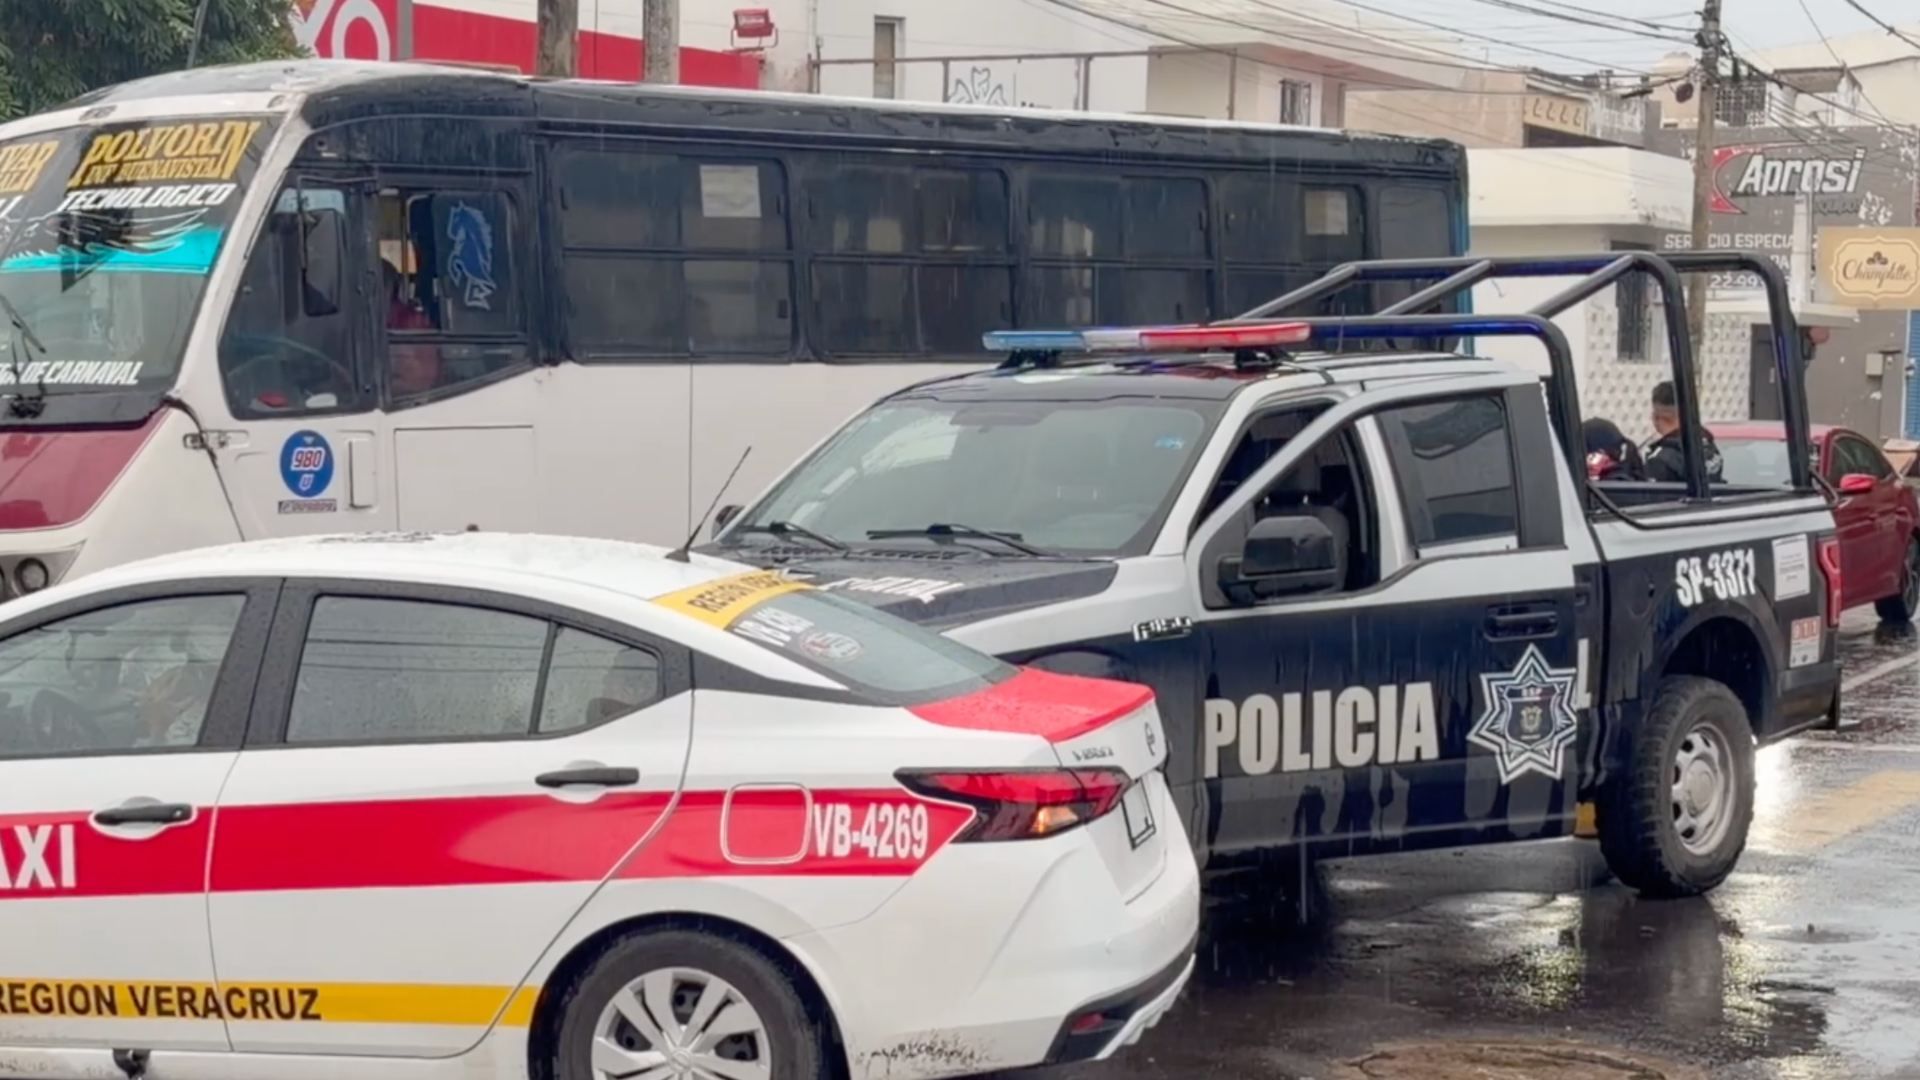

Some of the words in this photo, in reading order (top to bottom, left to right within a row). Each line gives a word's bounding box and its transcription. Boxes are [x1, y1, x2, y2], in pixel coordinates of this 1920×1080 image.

[67, 121, 260, 187] POLVORIN
[1738, 149, 1867, 196] Aprosi
[57, 184, 237, 211] TECNOLOGICO
[20, 360, 50, 385] DE
[43, 360, 143, 386] CARNAVAL
[292, 448, 325, 470] 980
[1204, 681, 1440, 778] POLICIA
[813, 803, 928, 860] VB-4269
[129, 984, 321, 1021] VERACRUZ
